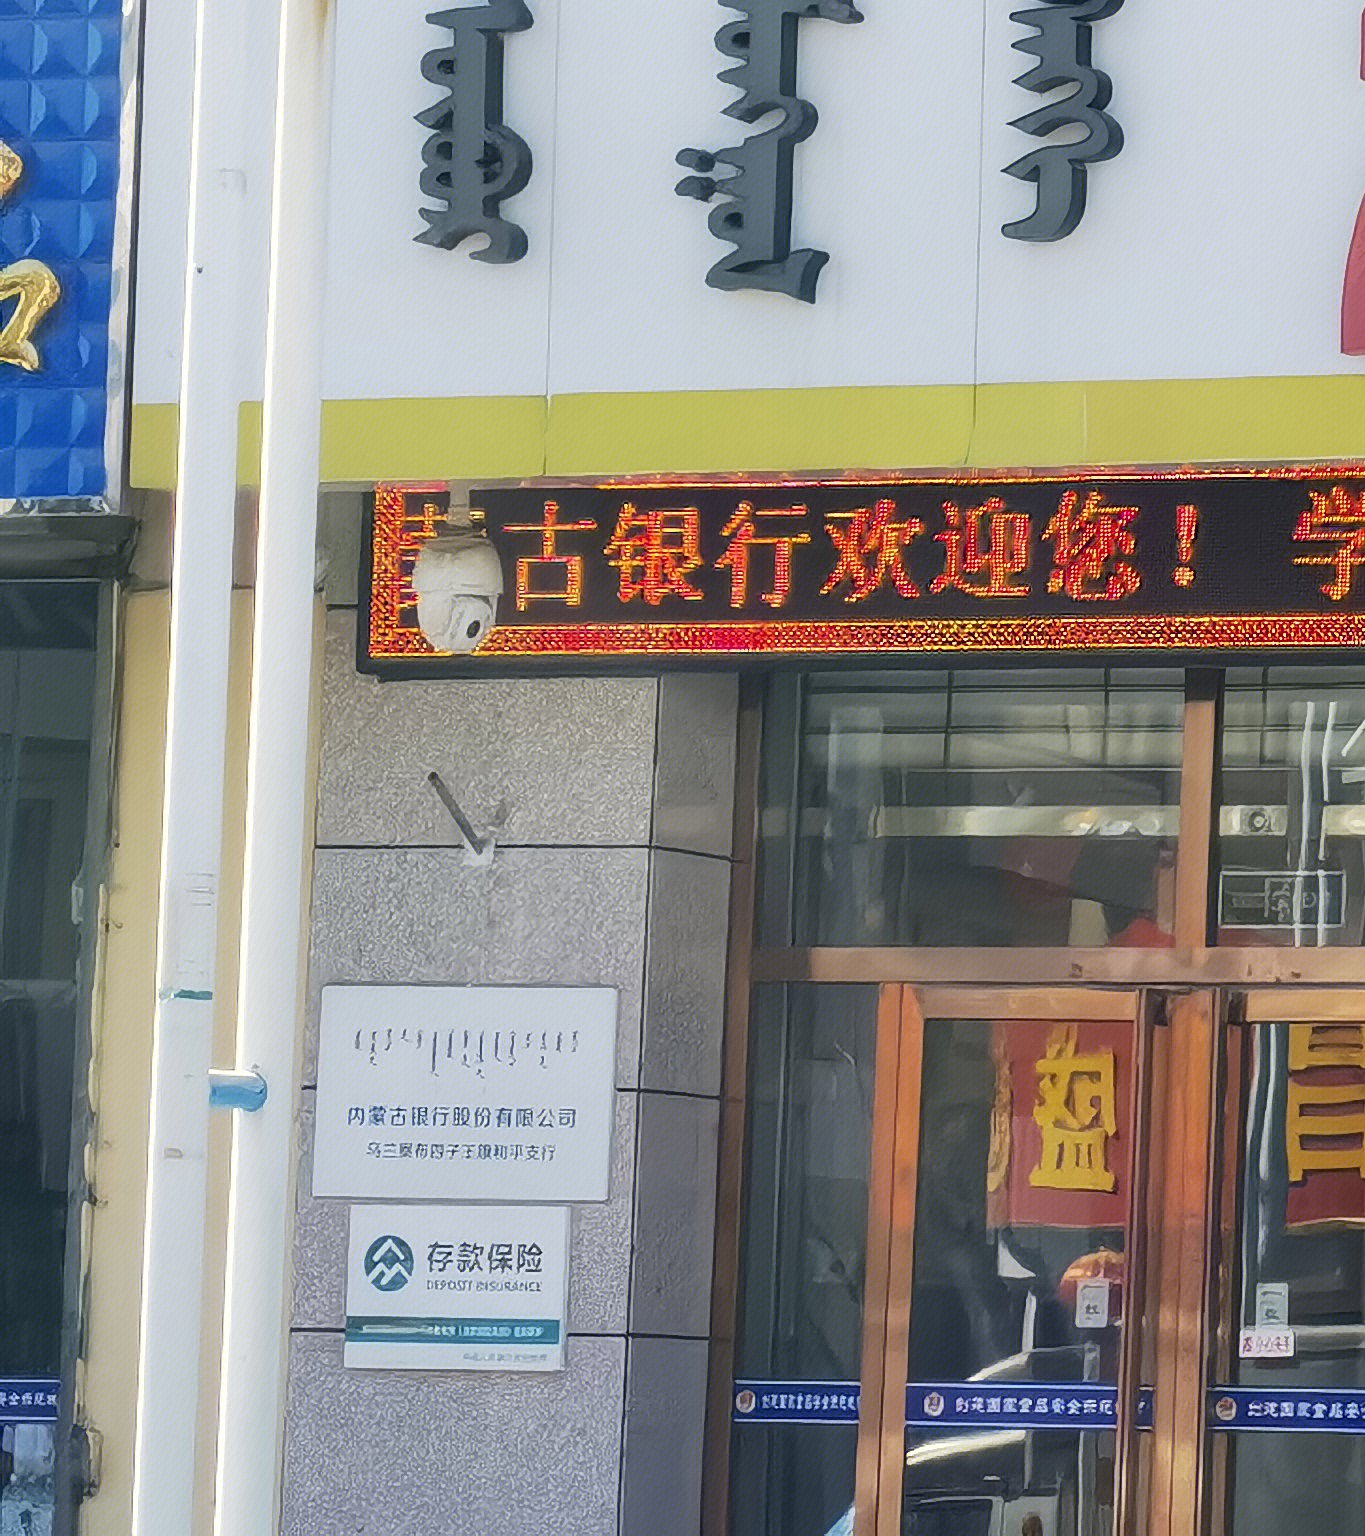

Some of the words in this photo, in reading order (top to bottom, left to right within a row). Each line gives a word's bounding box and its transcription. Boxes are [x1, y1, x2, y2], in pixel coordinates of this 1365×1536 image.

[347, 1105, 578, 1128] 内蒙古银行股份有限公司
[426, 1241, 543, 1274] 存款保险
